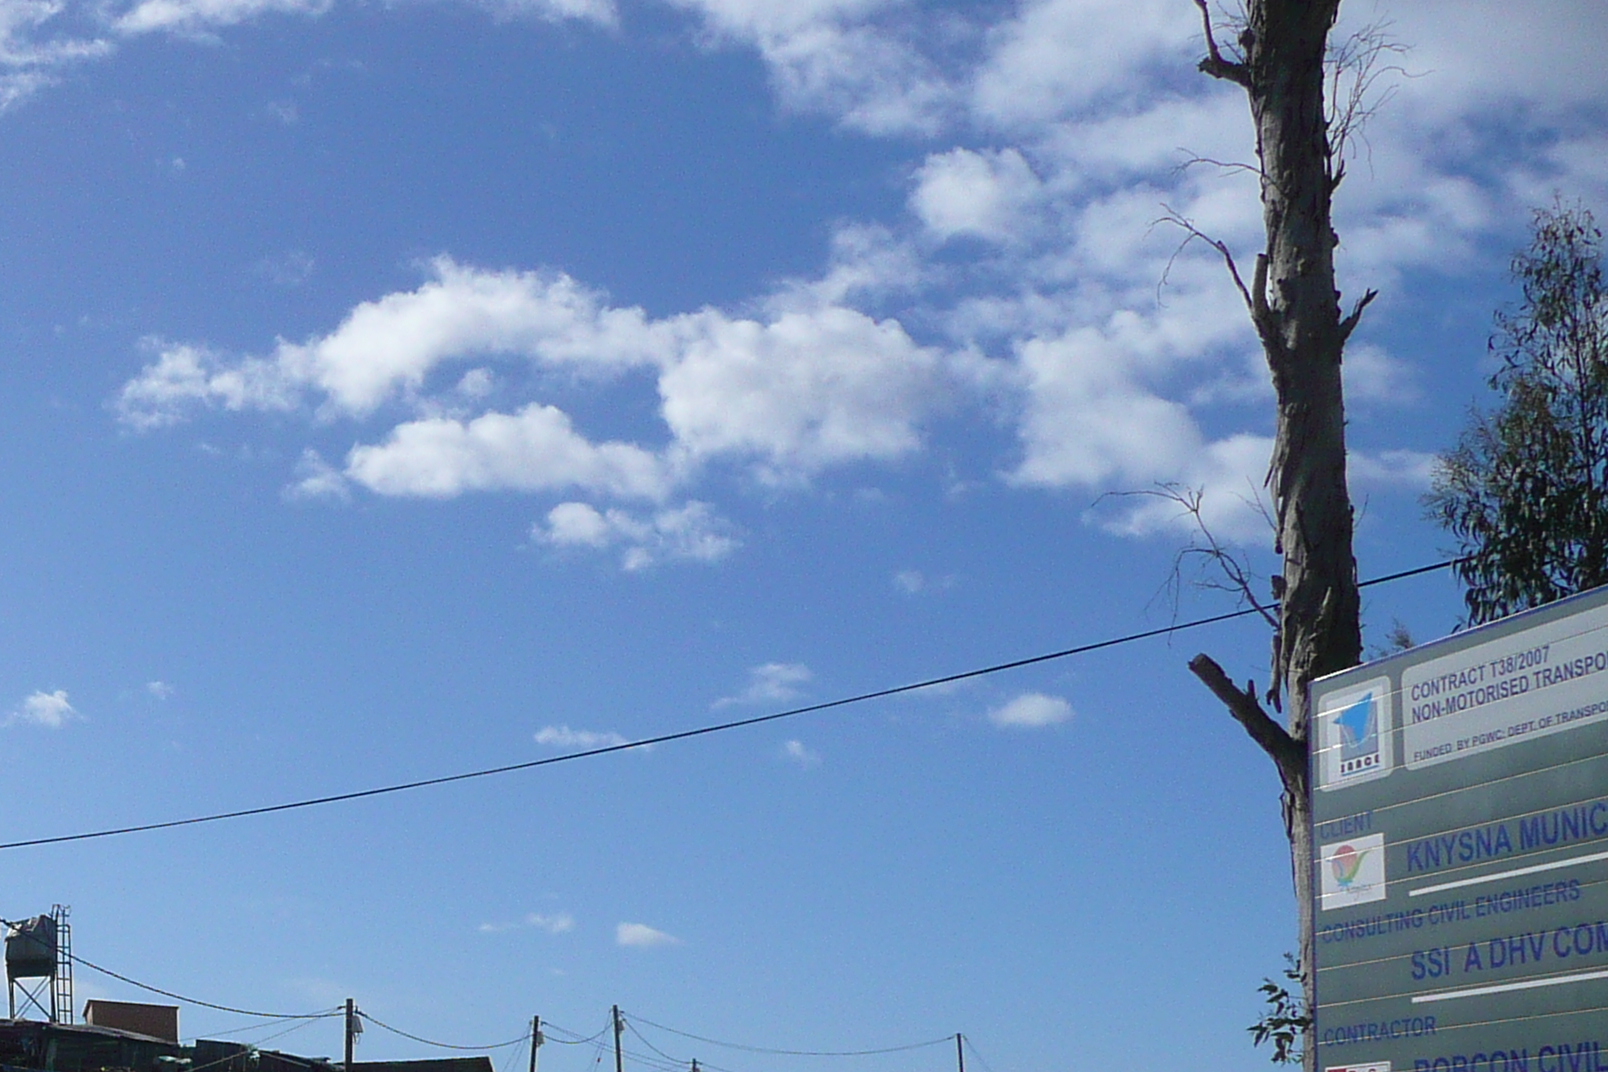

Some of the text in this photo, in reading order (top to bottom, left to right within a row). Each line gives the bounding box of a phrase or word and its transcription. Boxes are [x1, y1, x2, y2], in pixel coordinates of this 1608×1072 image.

[1411, 645, 1550, 702] CONTRACT T38/2007
[1411, 651, 1608, 724] NON-MOTORISED TRANSPO
[1413, 743, 1452, 762] FUNDED
[1457, 738, 1470, 751] BY
[1508, 721, 1536, 737] DEPT.
[1539, 716, 1552, 729] OF
[1555, 700, 1608, 724] TRANSPO
[1320, 810, 1373, 839] CLIENT
[1406, 802, 1608, 872] KNYSNA MUNIC
[1322, 879, 1580, 944] CONSULTING CIVIL ENGINEERS
[1411, 947, 1450, 981] SSI
[1464, 942, 1482, 973] A
[1490, 930, 1546, 969] DHV
[1323, 1015, 1437, 1047] CONTRACTOR
